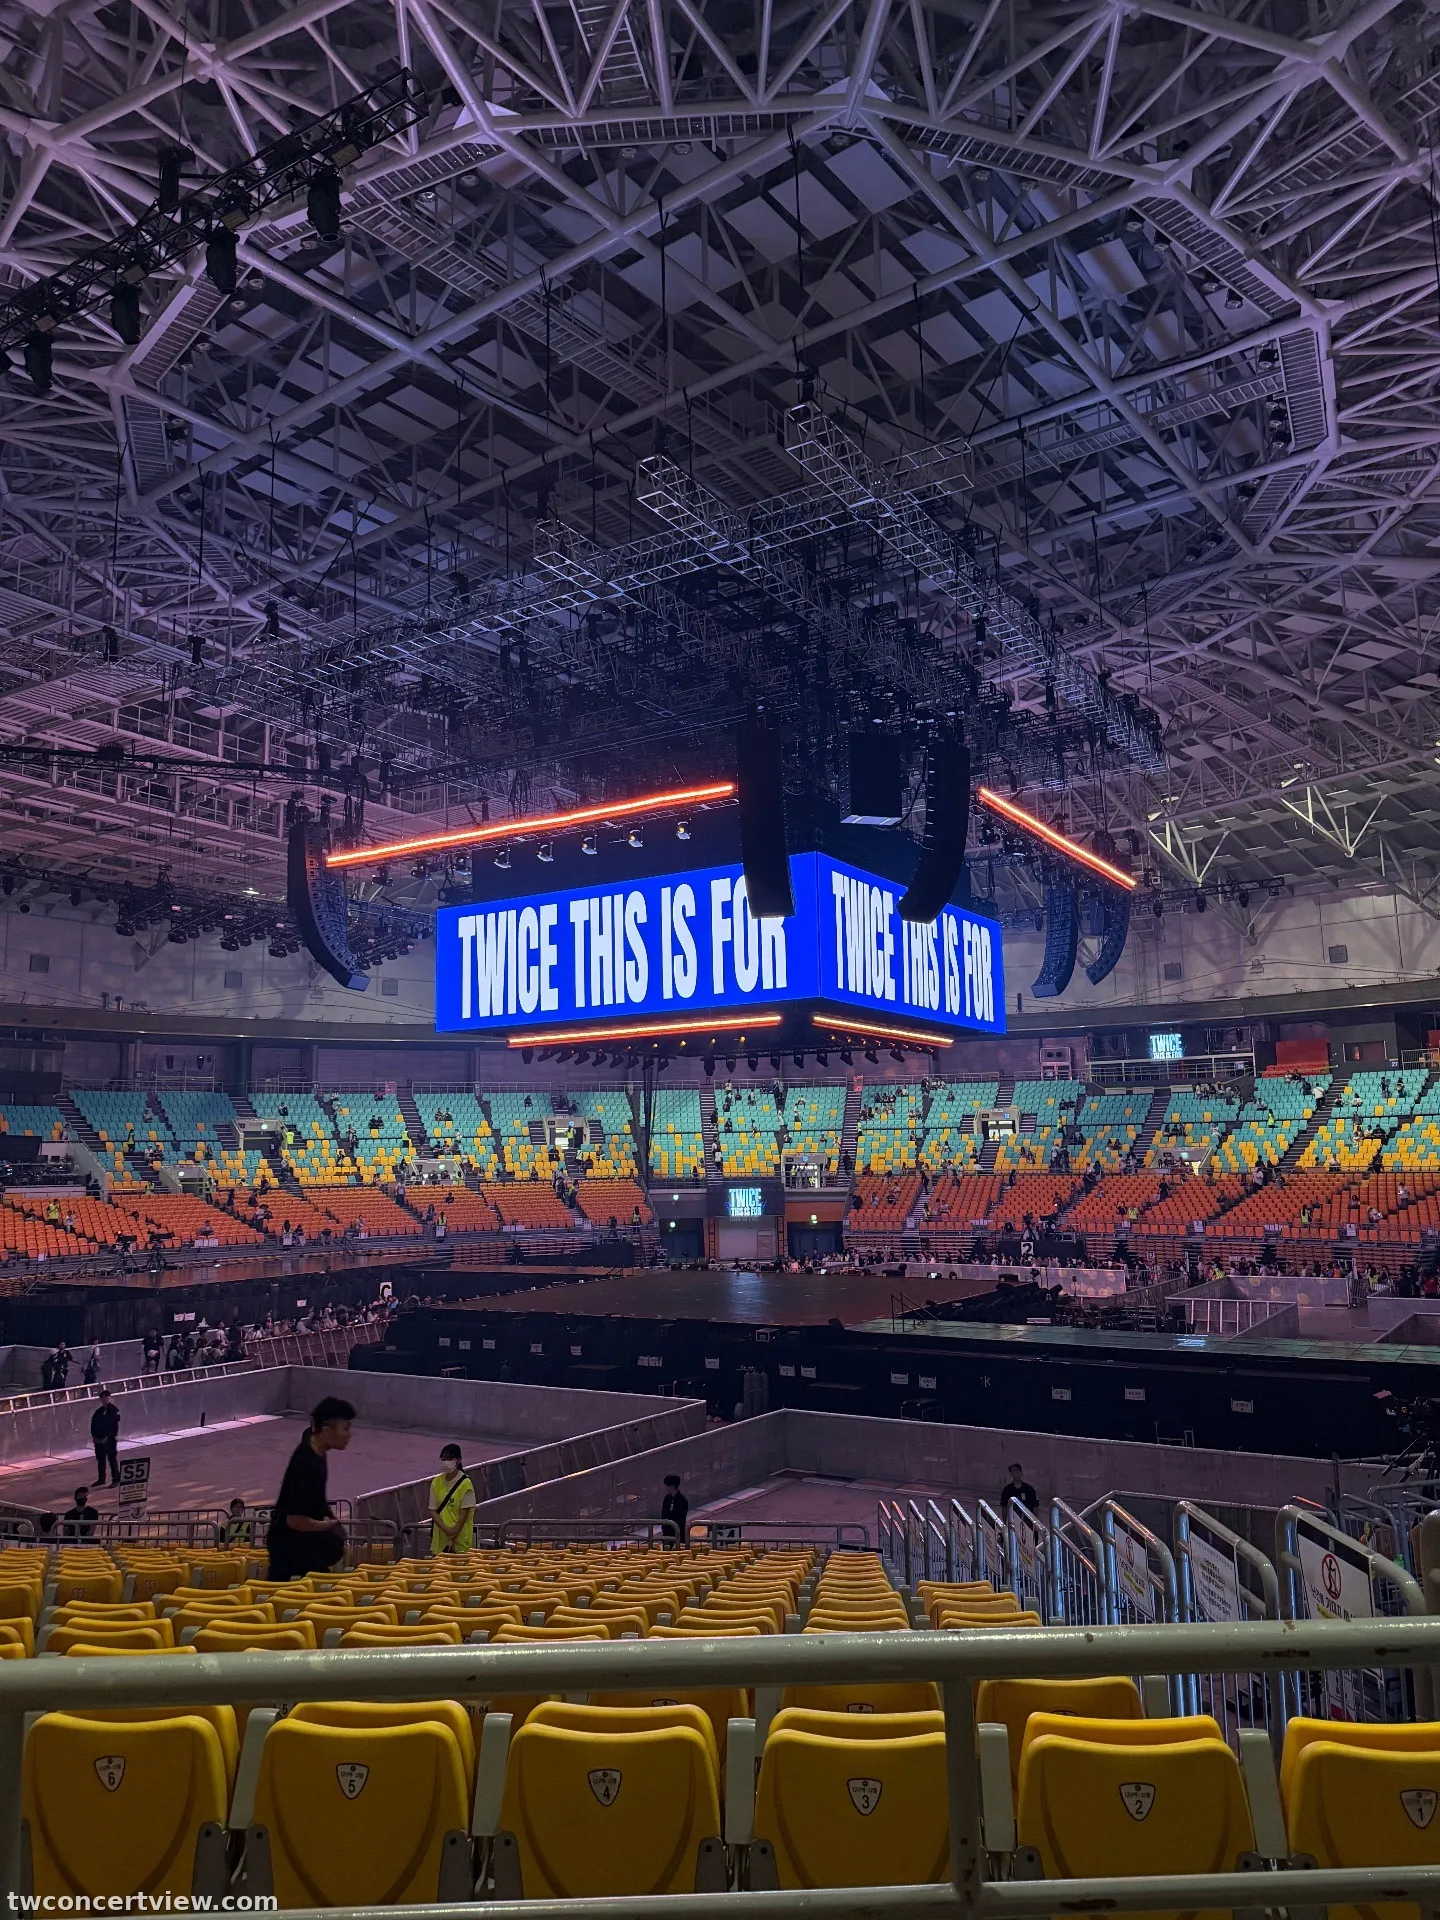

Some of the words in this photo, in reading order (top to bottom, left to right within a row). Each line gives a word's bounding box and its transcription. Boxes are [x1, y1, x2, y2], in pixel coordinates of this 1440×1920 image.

[458, 904, 558, 1018] TWICE
[570, 891, 648, 1007] THIS
[661, 883, 698, 999] IS
[711, 874, 787, 994] FOR
[832, 871, 895, 1001] TWICE
[899, 896, 940, 1011] THIS
[942, 912, 960, 1015] IS
[962, 919, 994, 1022] FOR
[1150, 1033, 1182, 1052] TWICE
[729, 1188, 762, 1207] TWICE
[731, 1207, 744, 1216] THIS
[123, 1463, 145, 1480] S5
[108, 1771, 116, 1786] 6
[348, 1779, 356, 1794] 5
[602, 1785, 611, 1800] 4
[861, 1794, 870, 1809] 3
[1135, 1799, 1144, 1815] 2
[1417, 1807, 1424, 1821] 1
